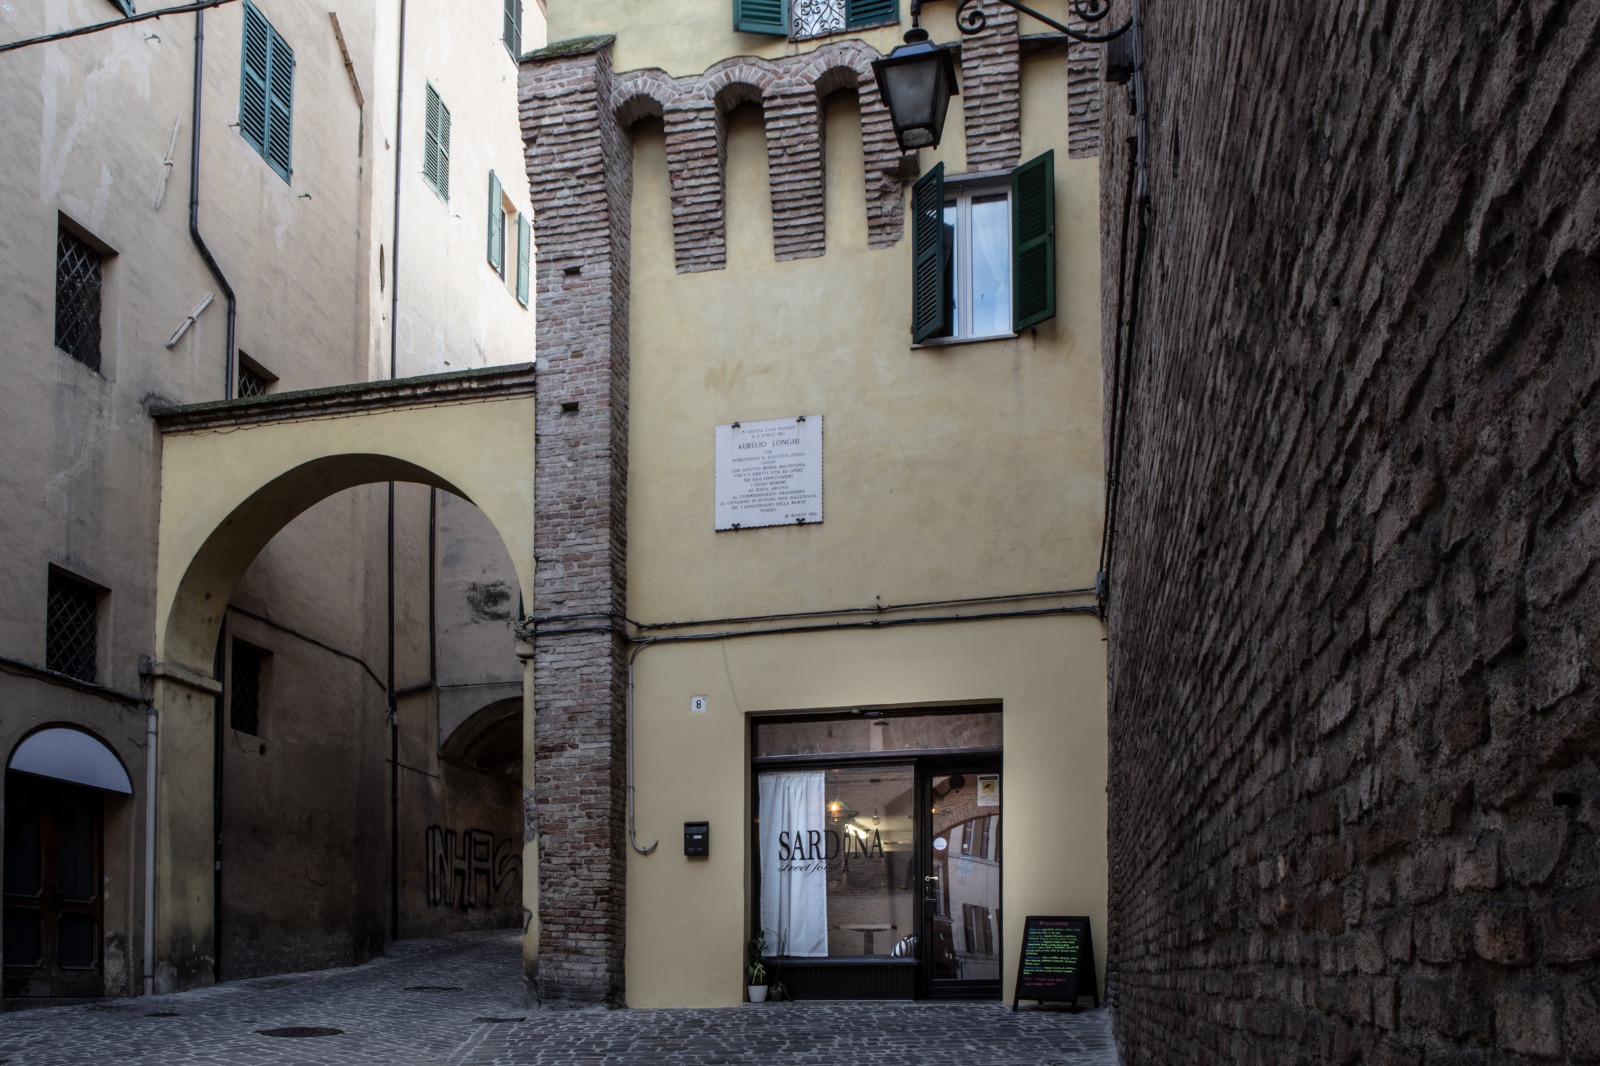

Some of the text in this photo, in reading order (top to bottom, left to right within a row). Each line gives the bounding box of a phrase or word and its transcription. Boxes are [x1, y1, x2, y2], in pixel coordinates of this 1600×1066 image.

[738, 442, 767, 450] AURELIO
[696, 700, 702, 710] 8
[779, 827, 885, 867] SARDINA
[778, 860, 844, 875] street food
